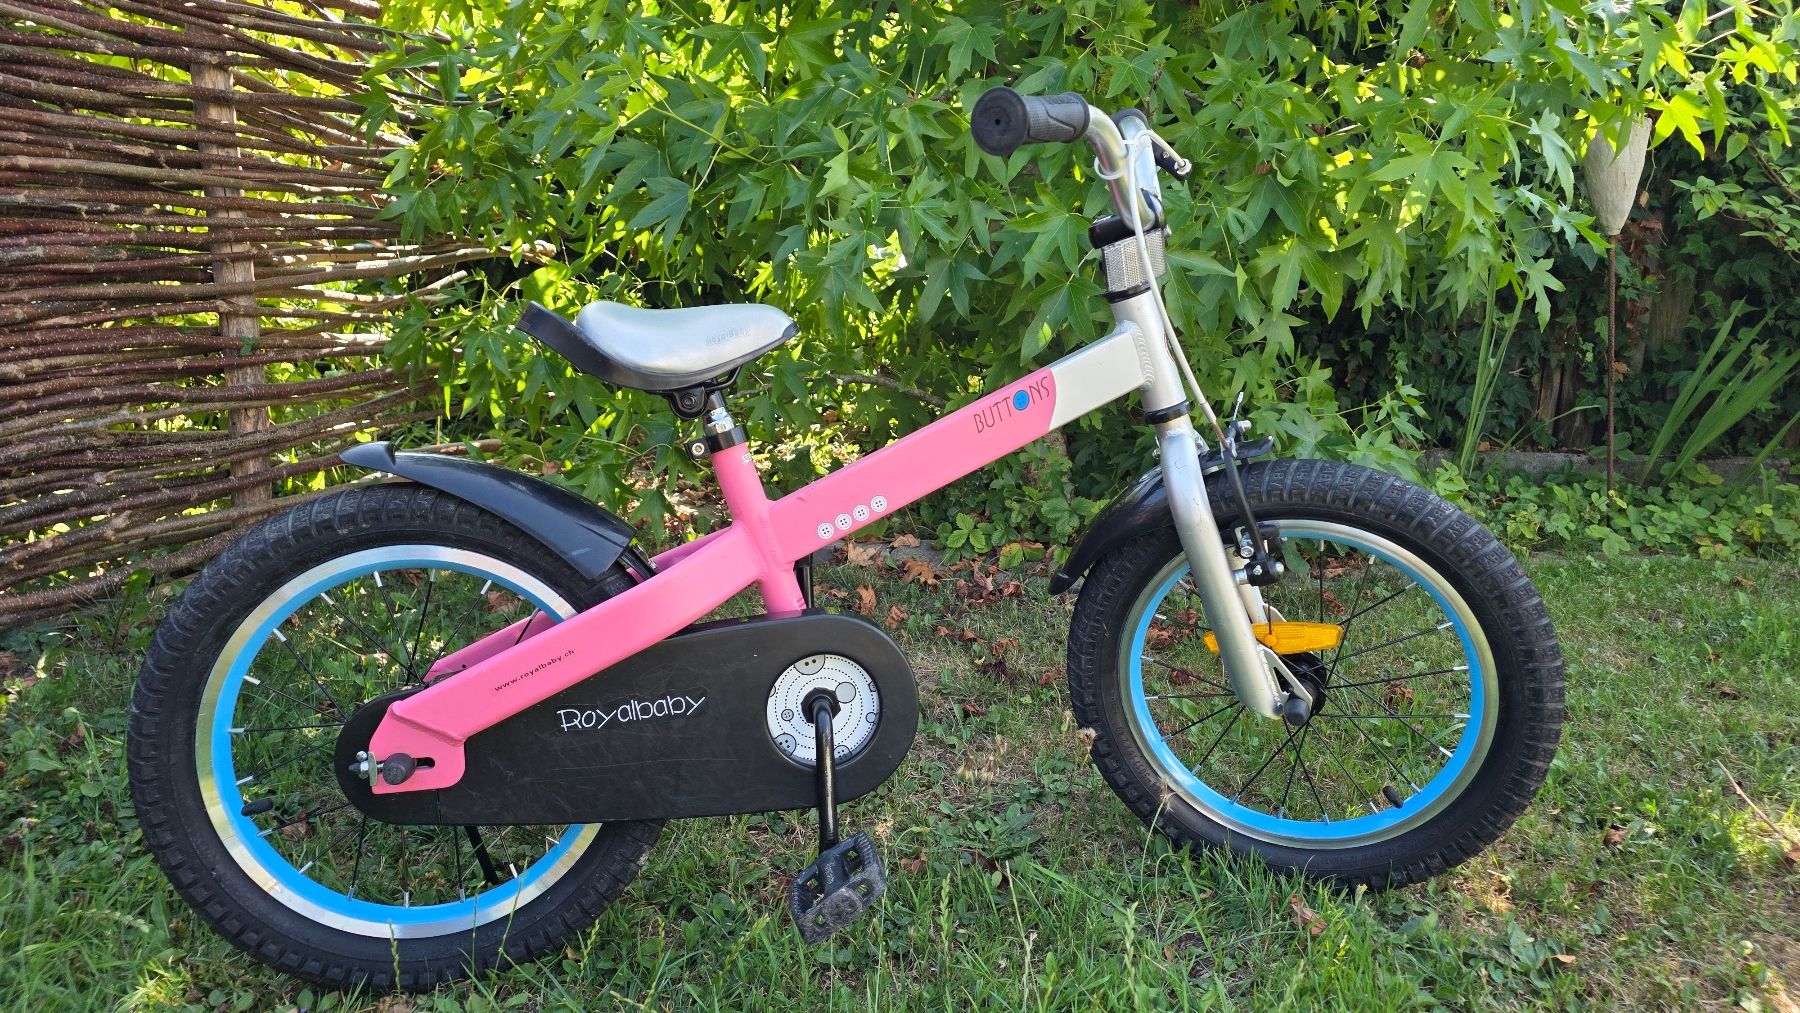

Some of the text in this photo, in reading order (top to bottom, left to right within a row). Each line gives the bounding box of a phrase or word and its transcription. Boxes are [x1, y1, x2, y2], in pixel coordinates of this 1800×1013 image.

[974, 376, 1050, 434] BUTTONS
[494, 649, 575, 691] www.royalbaby.ch
[556, 695, 706, 732] Royalbaby
